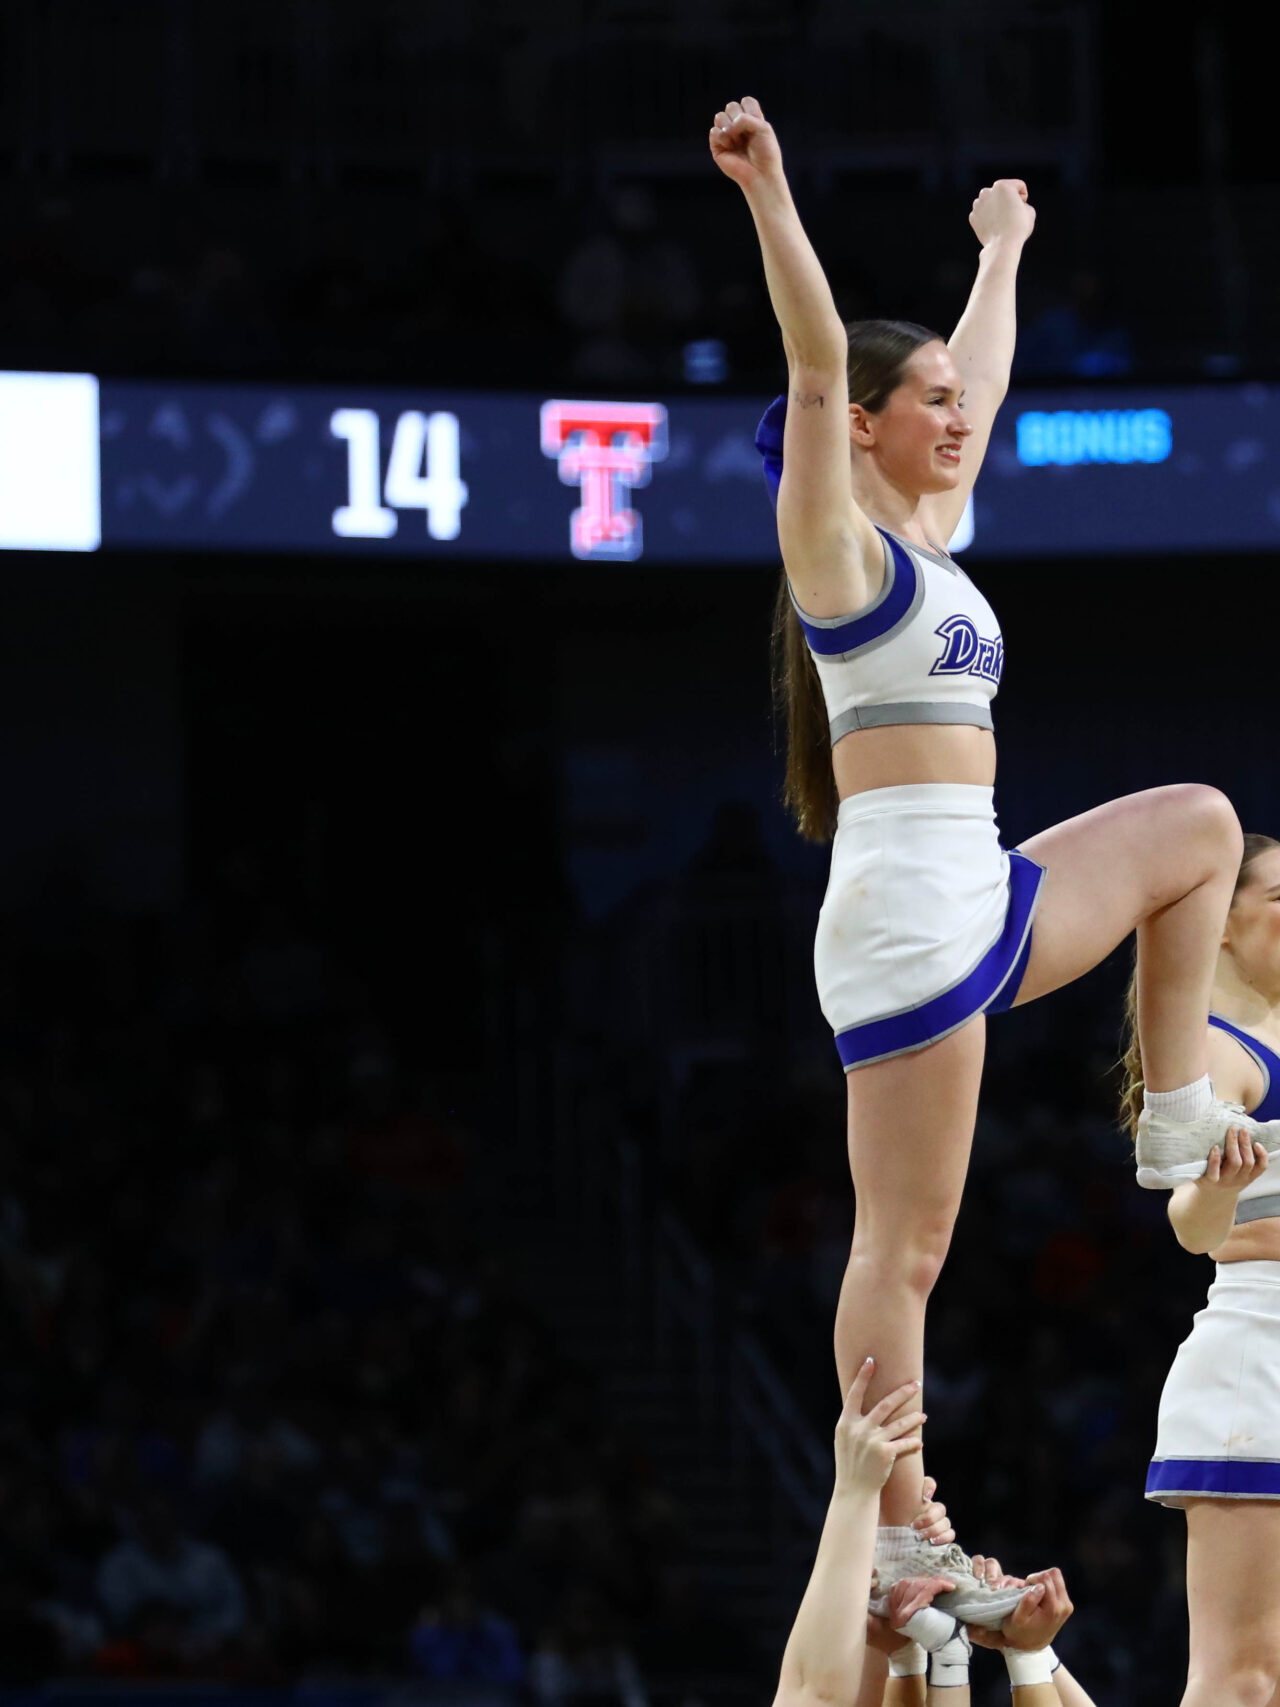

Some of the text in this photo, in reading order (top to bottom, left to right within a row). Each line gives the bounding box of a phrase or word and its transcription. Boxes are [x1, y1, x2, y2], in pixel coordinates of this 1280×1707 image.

[1016, 408, 1173, 466] BONUS
[330, 408, 468, 540] 14
[928, 613, 1004, 686] Drak
